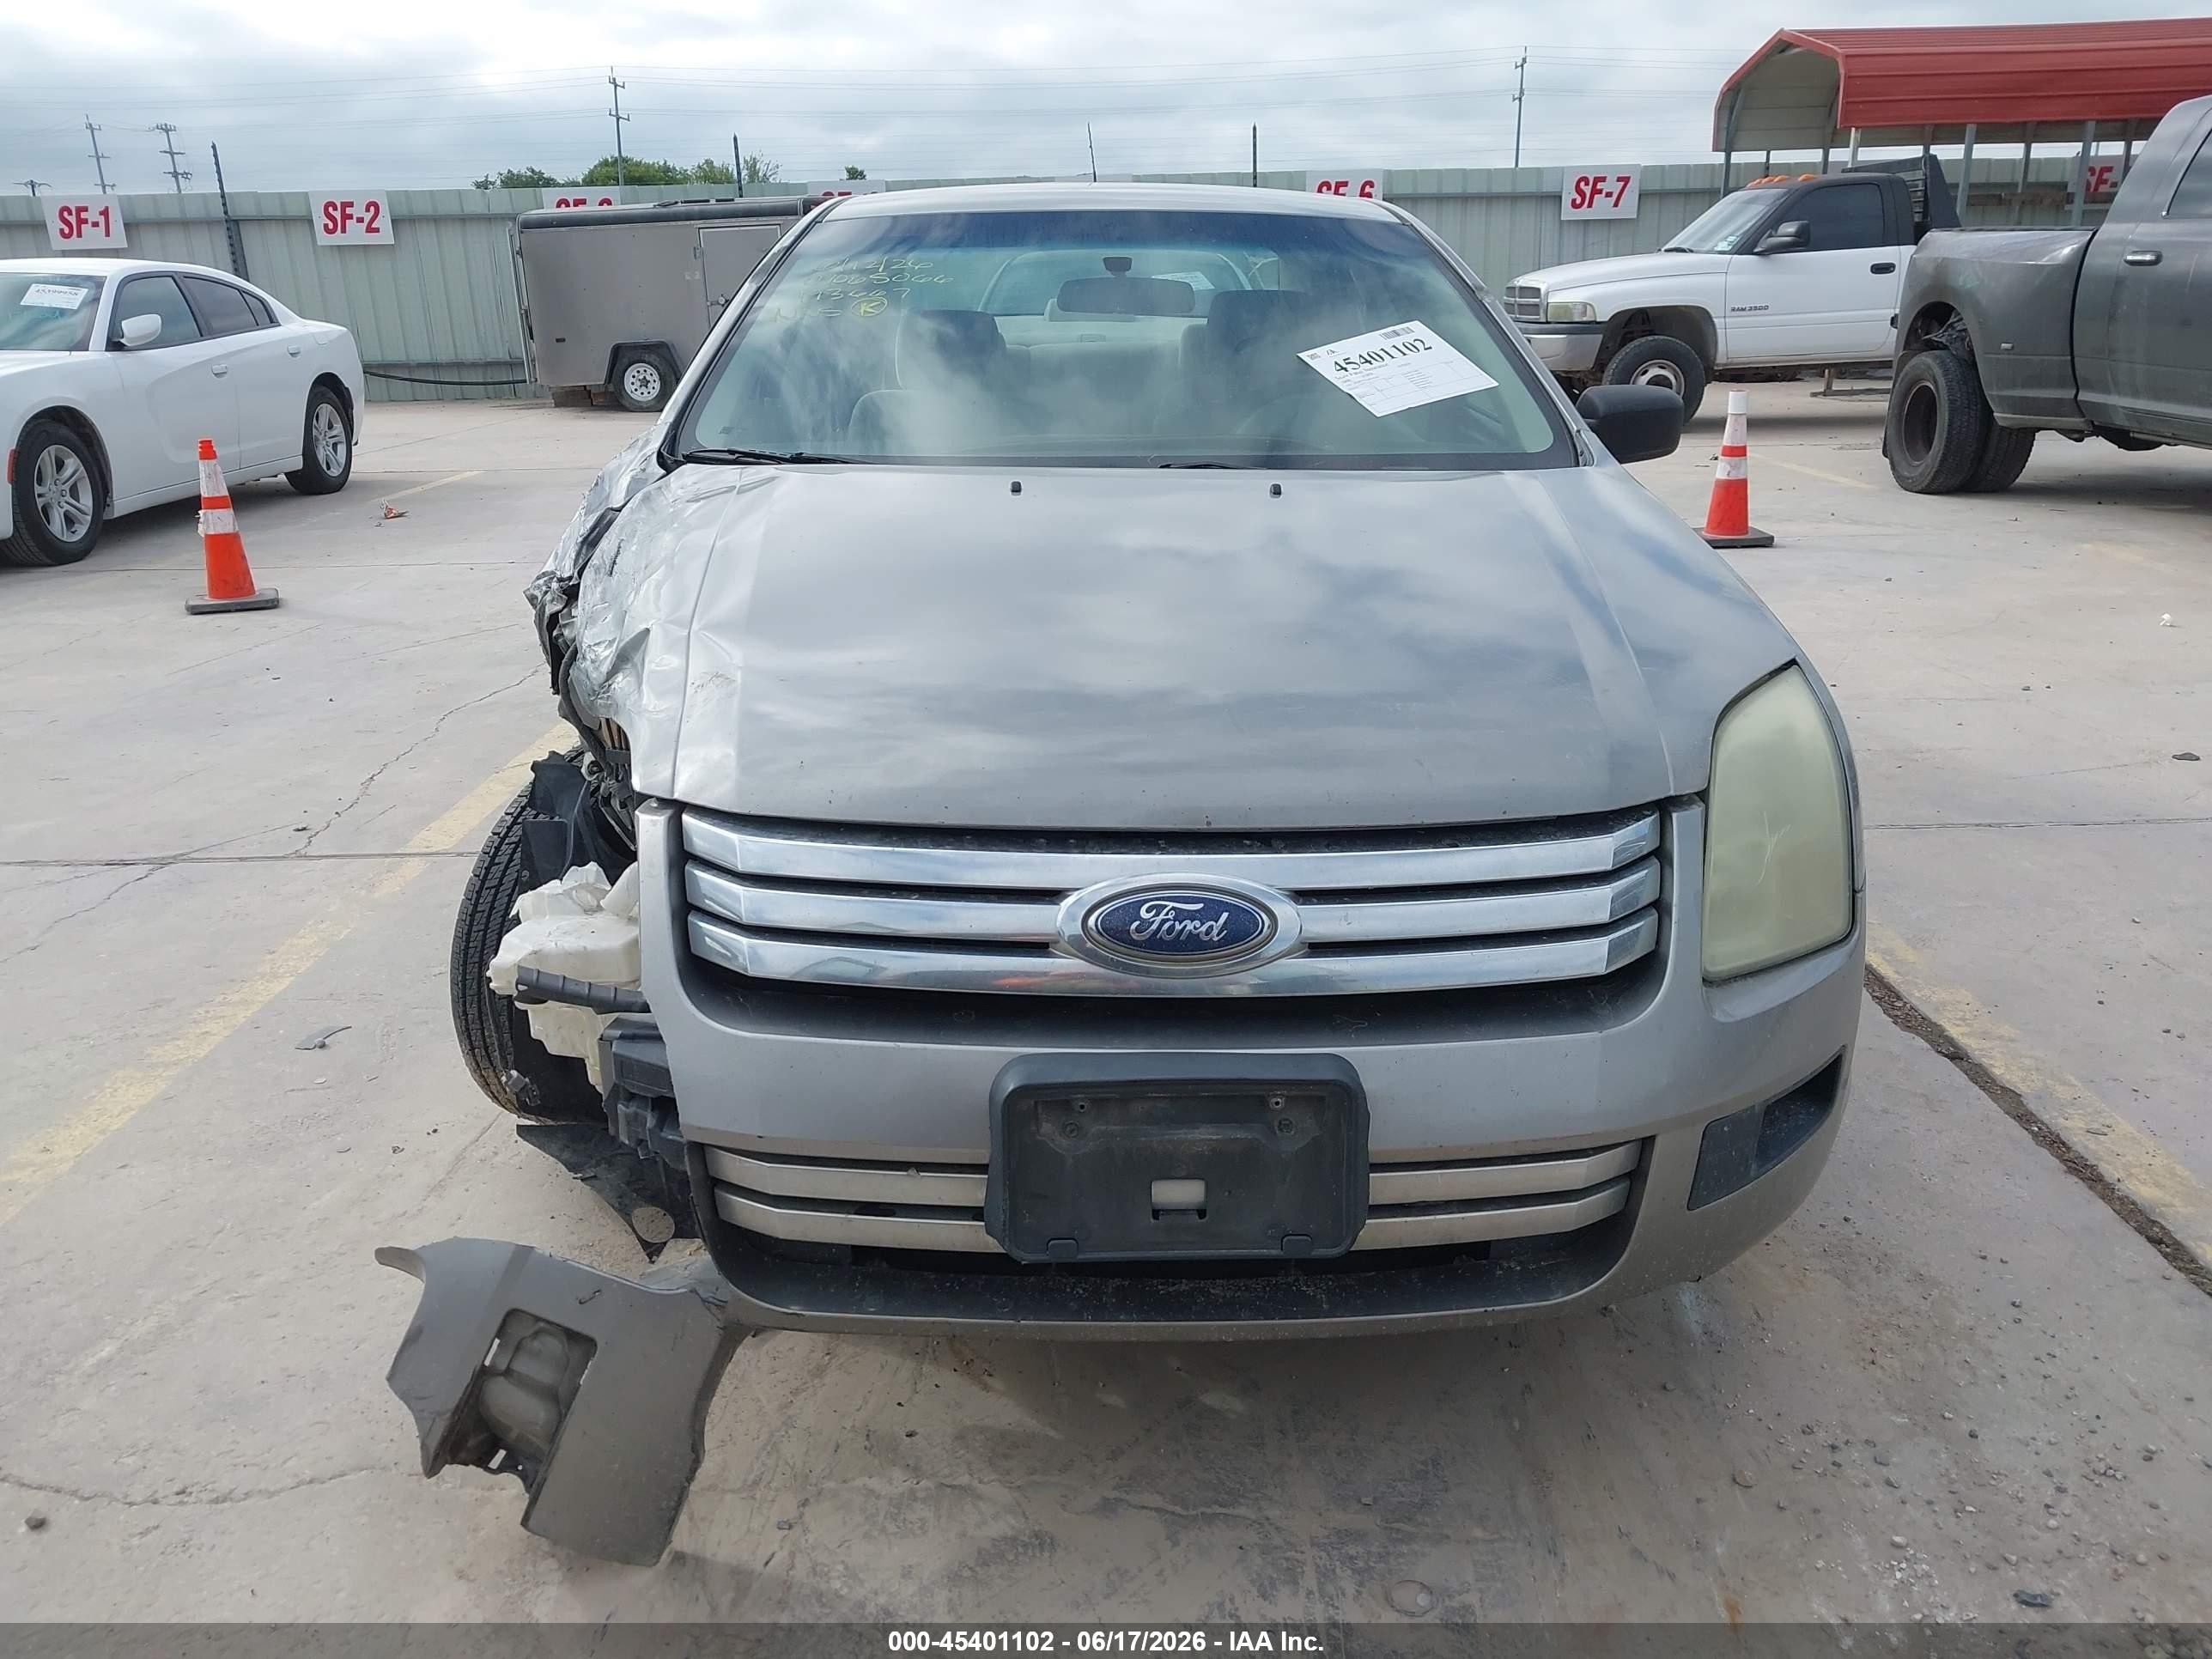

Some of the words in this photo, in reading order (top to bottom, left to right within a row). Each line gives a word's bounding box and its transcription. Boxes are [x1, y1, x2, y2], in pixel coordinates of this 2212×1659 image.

[1571, 175, 1632, 210] SF-7
[58, 205, 111, 240] SF-1
[323, 200, 380, 234] SF-2
[1334, 338, 1433, 374] 45401102
[1130, 901, 1230, 941] Ford
